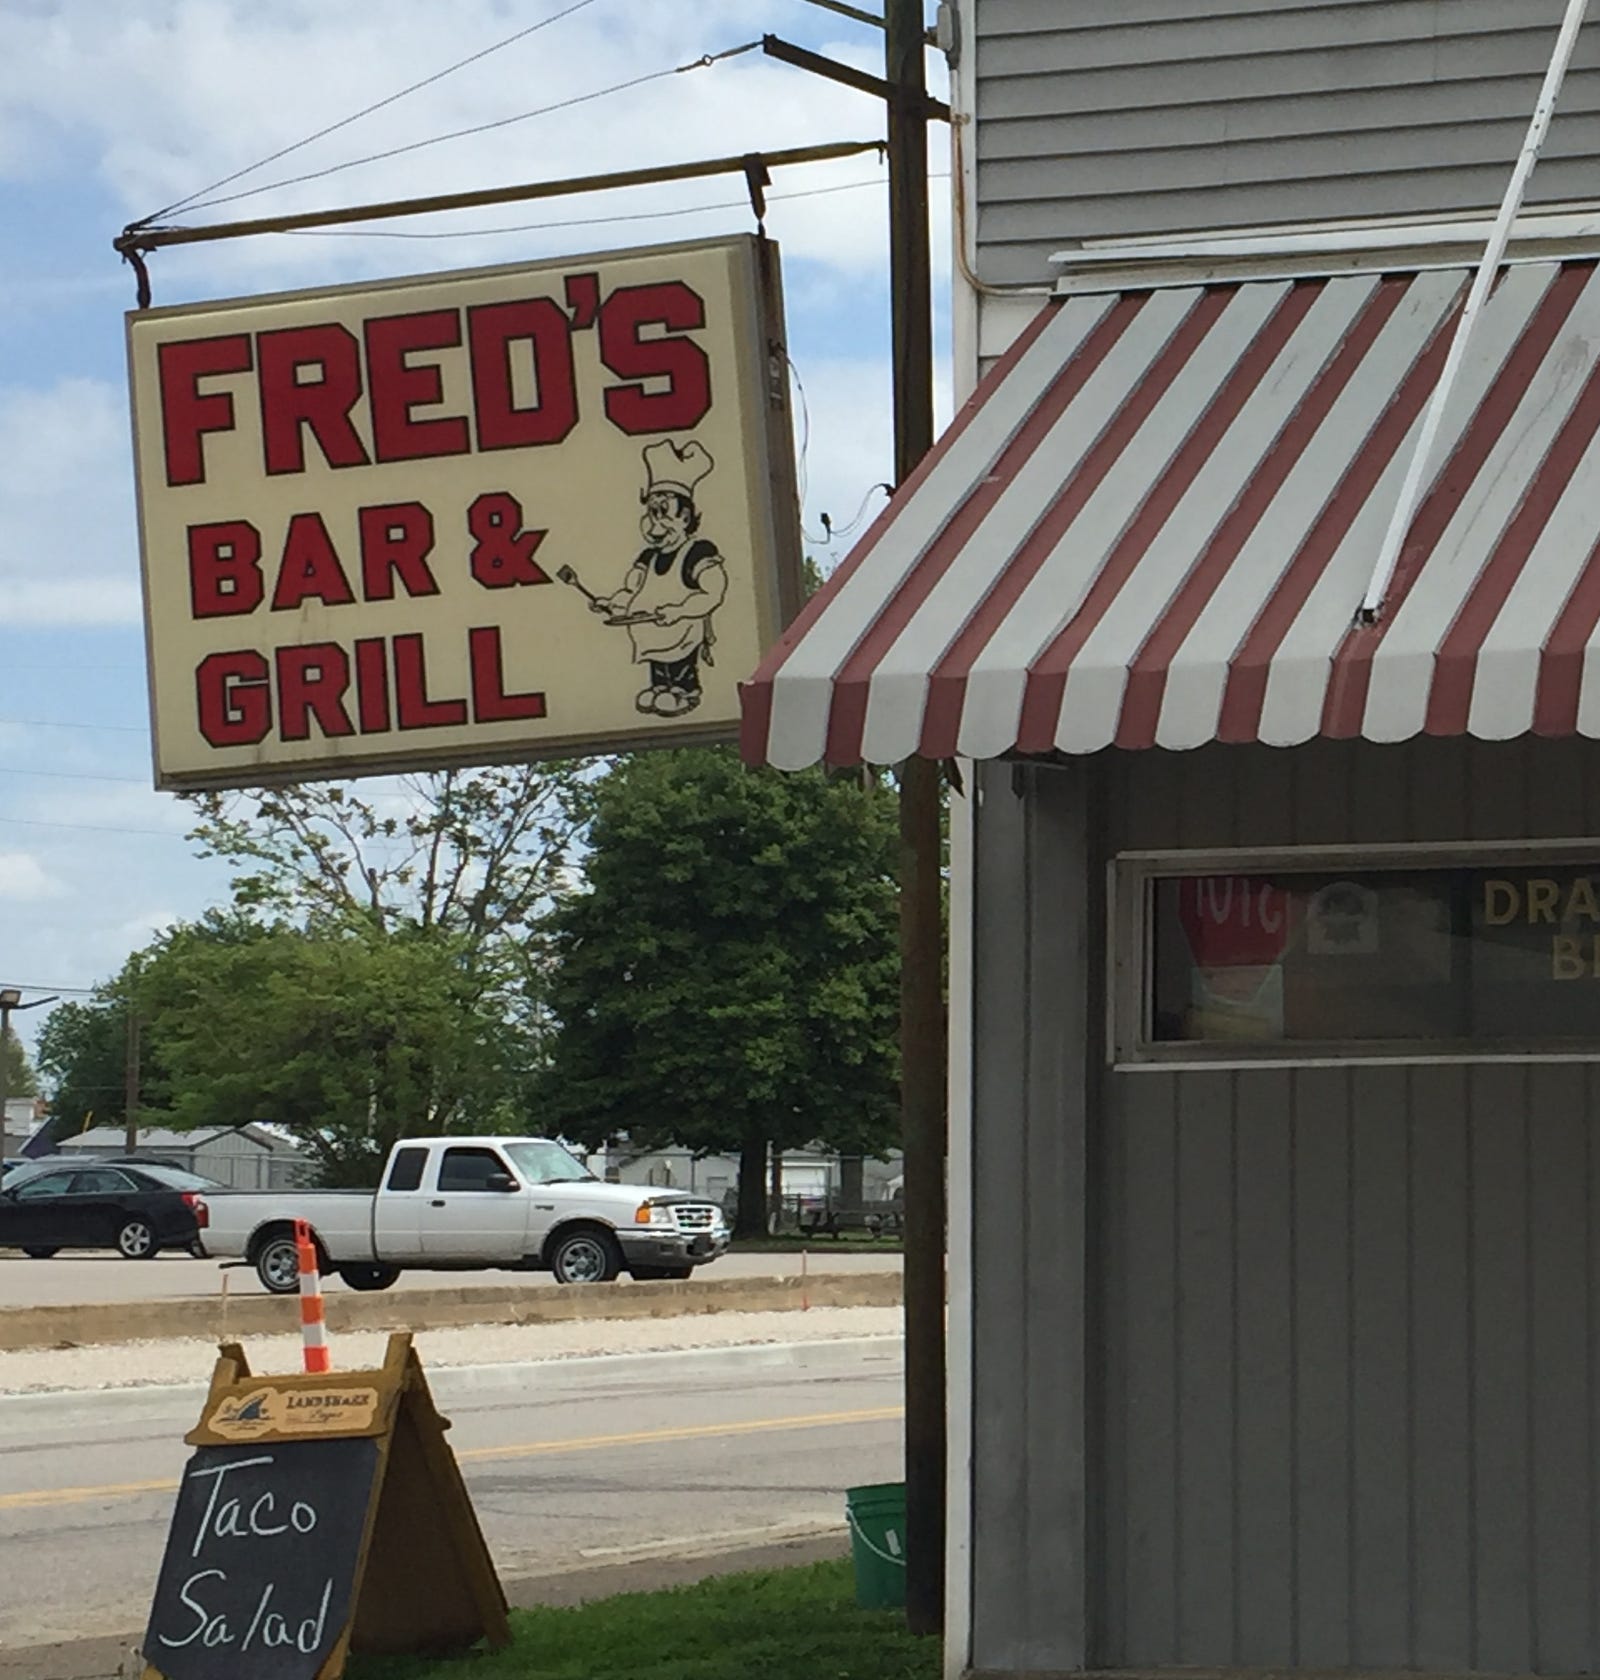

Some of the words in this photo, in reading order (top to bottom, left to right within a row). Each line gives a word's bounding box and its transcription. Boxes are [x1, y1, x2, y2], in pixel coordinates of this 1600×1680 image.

[157, 272, 712, 487] FRED'S
[187, 501, 440, 619] BAR
[467, 491, 553, 589] &
[195, 626, 546, 748] GRILL
[190, 1456, 317, 1558] Taco
[158, 1570, 334, 1654] Salad
